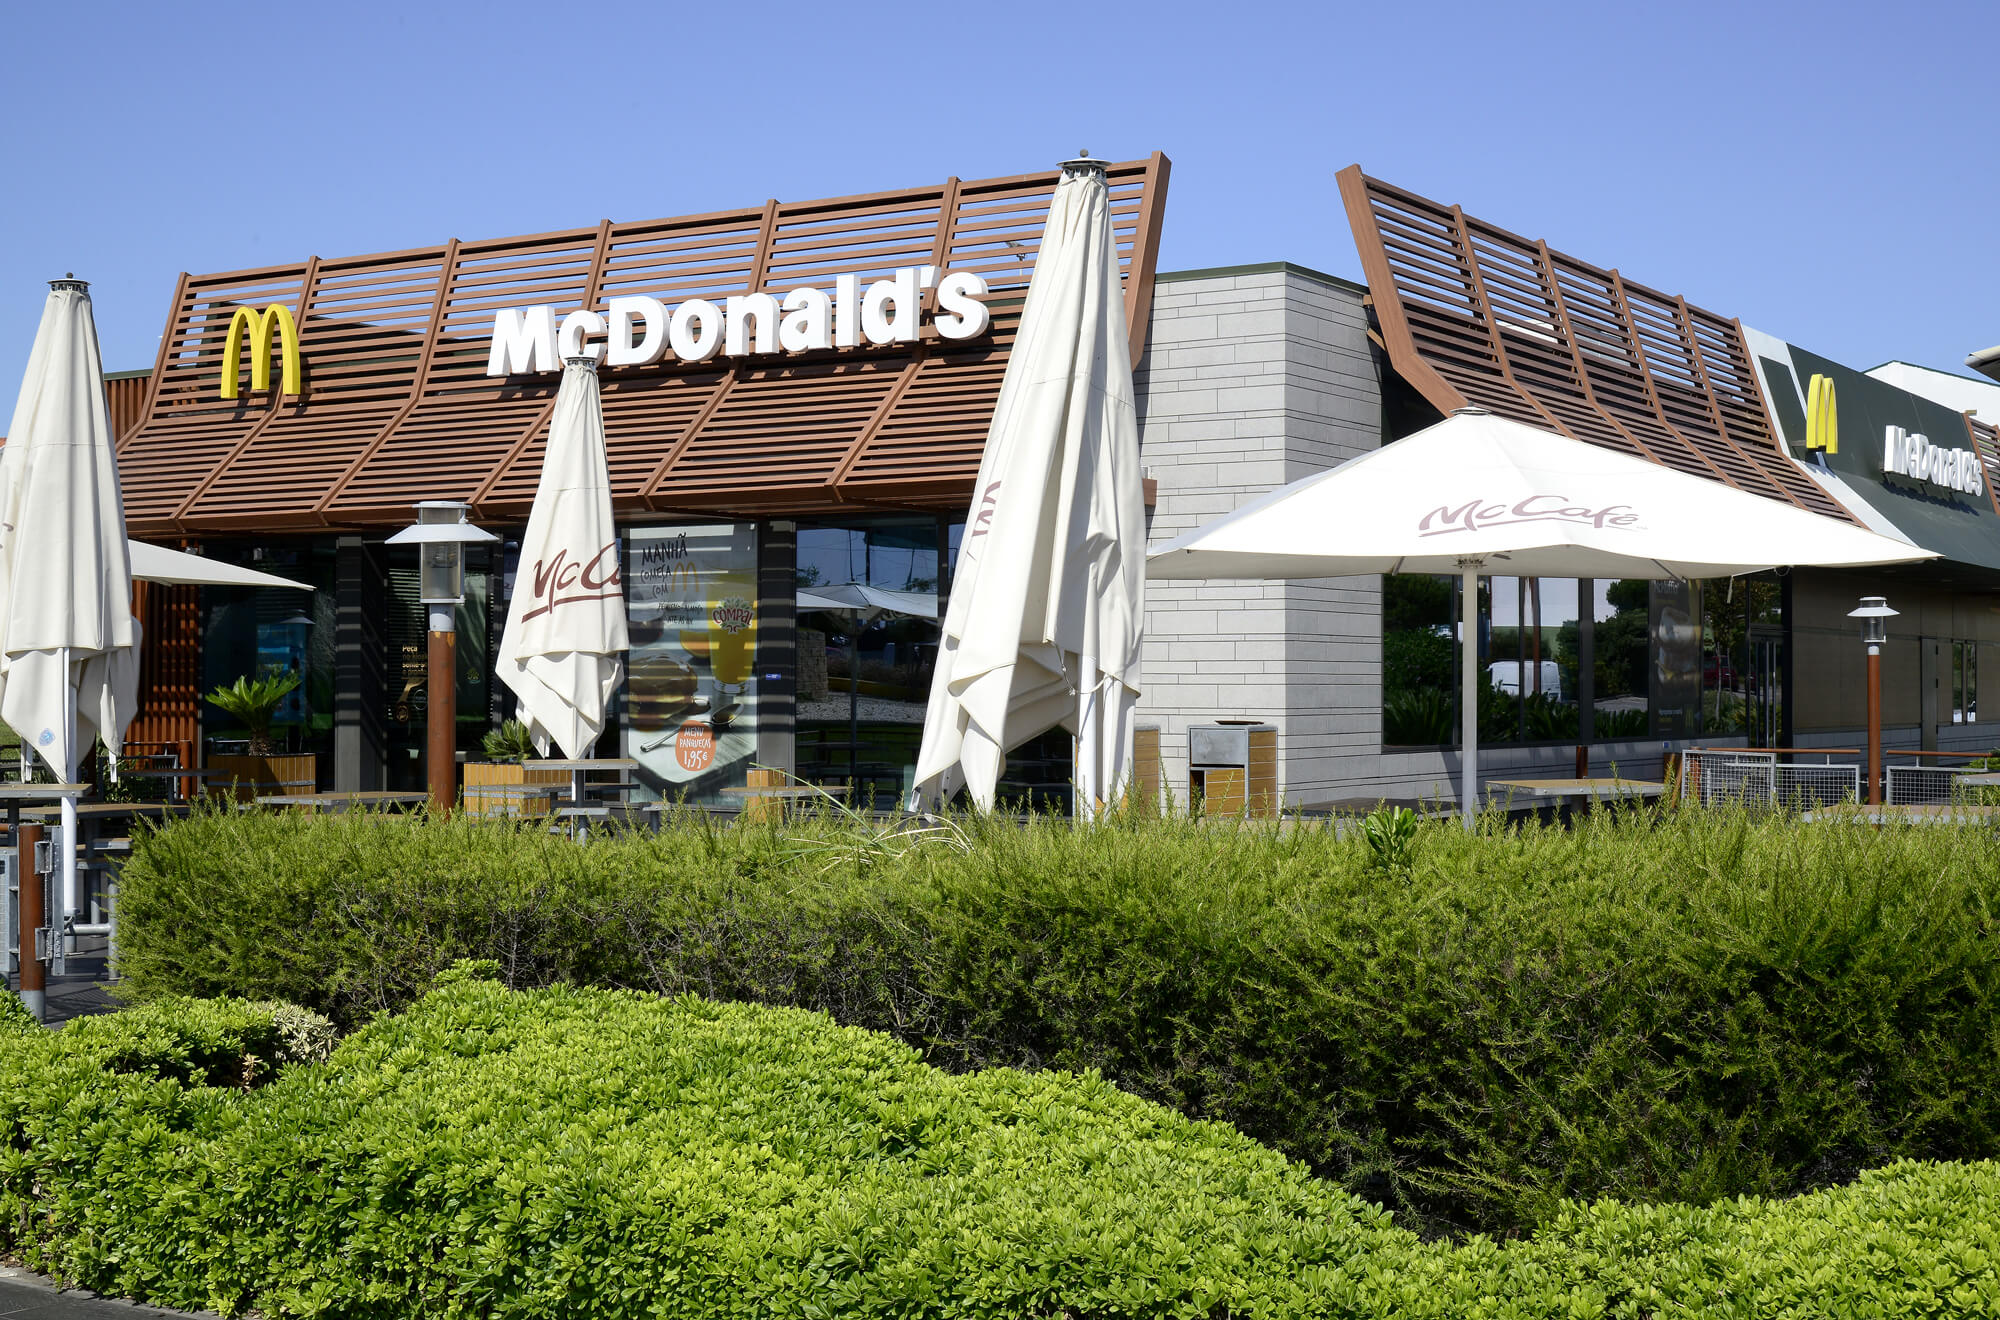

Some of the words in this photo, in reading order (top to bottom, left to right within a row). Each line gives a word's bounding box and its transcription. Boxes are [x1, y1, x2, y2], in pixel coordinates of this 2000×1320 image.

[487, 266, 990, 377] McDonald's
[1884, 425, 1982, 496] McDonald's
[641, 532, 688, 566] MANHÃ
[641, 564, 672, 584] COMEÇA
[684, 727, 704, 737] MENU
[684, 750, 708, 769] 1,95€
